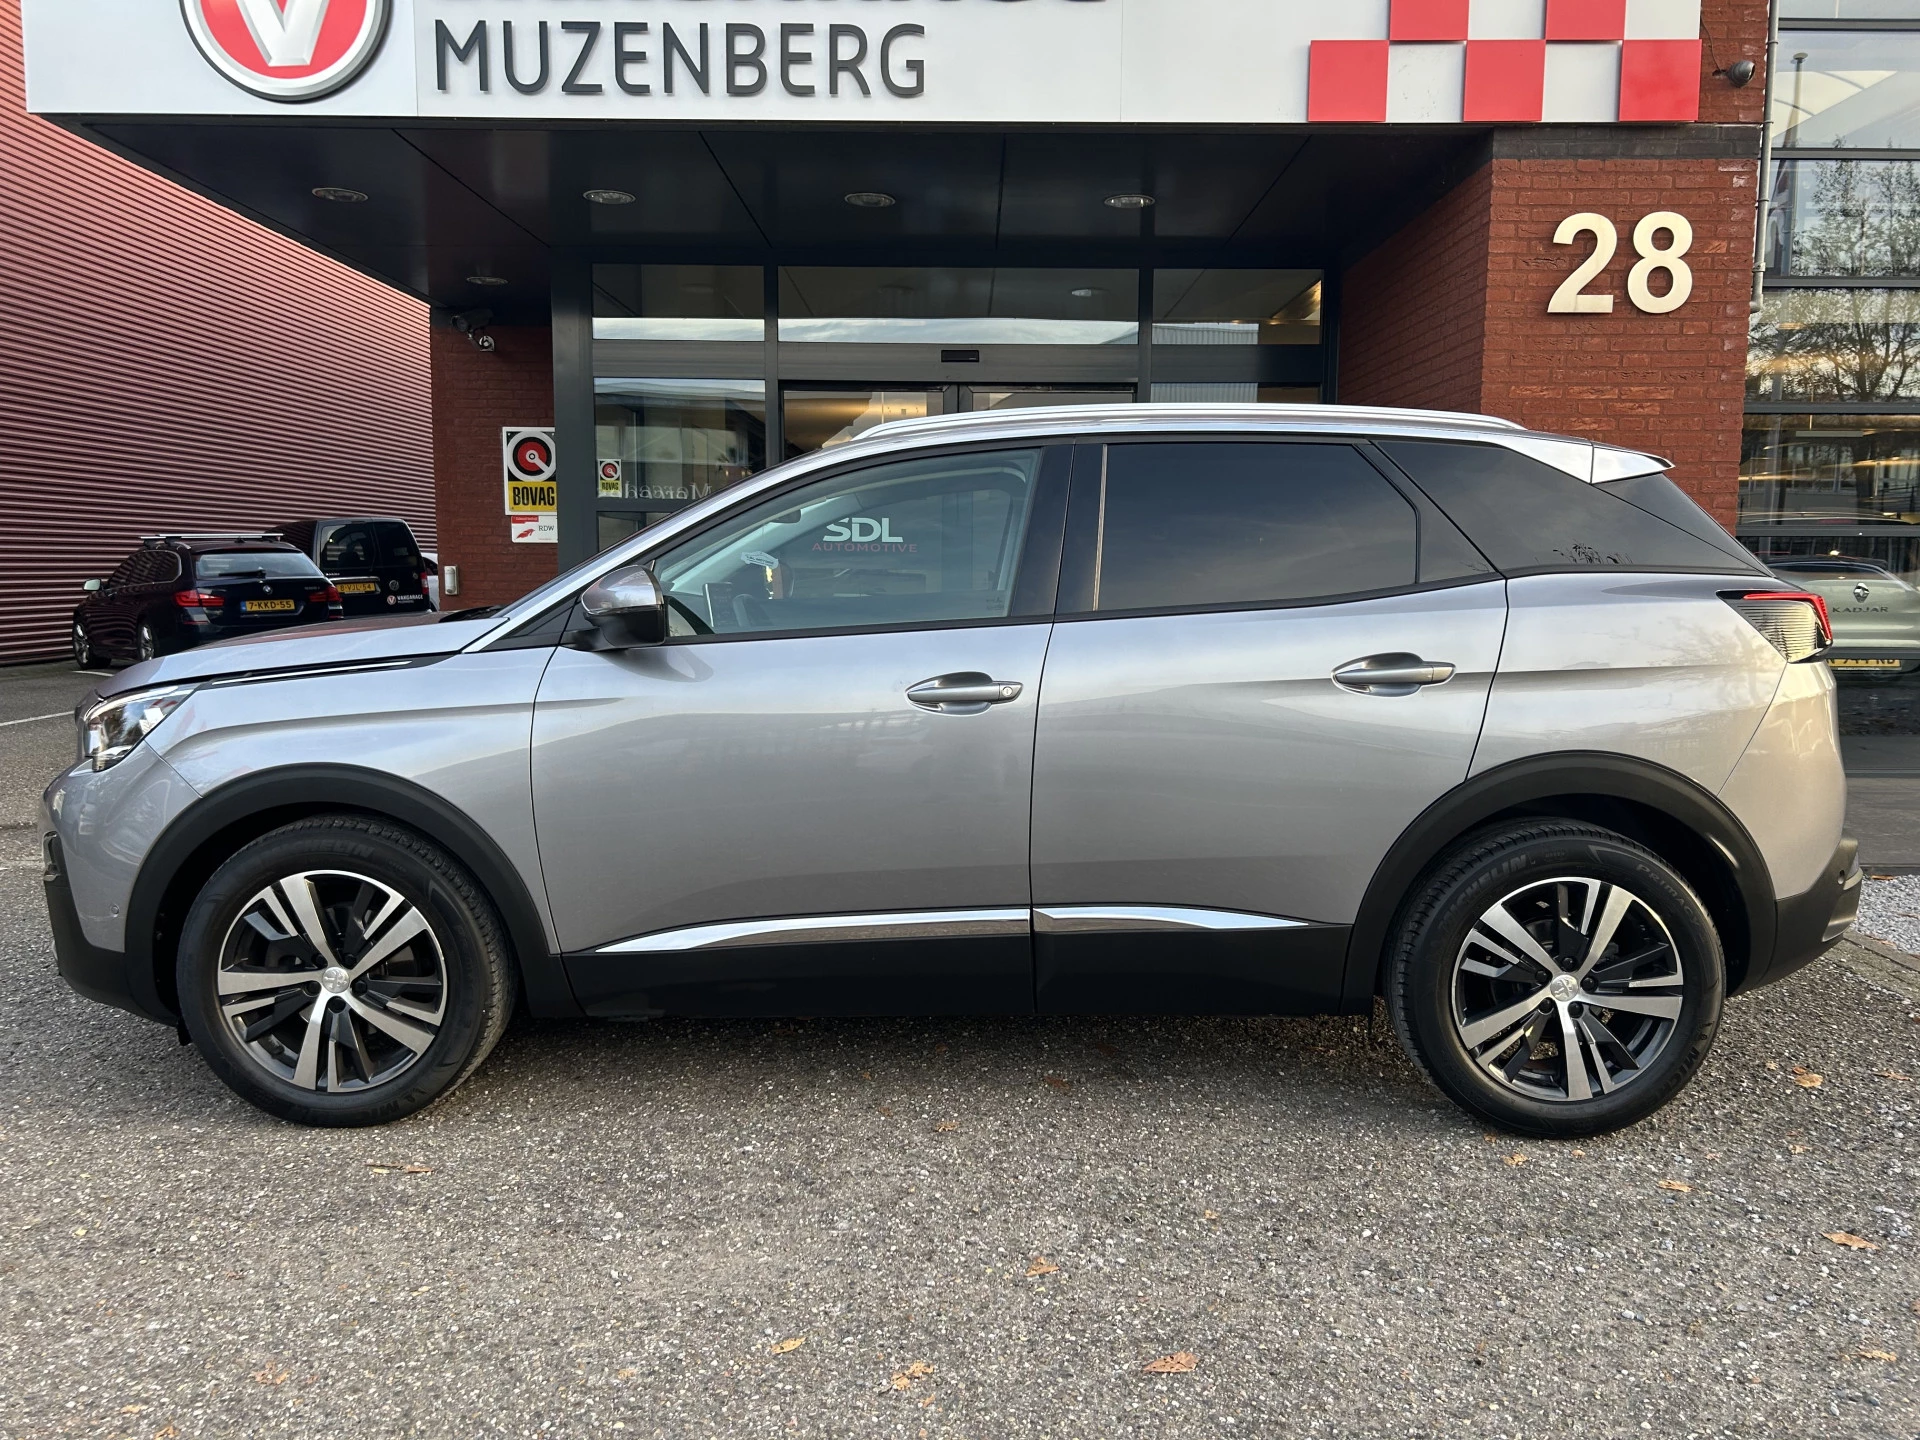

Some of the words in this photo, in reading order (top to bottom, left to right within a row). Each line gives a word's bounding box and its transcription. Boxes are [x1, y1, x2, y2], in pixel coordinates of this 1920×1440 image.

[434, 20, 926, 98] MUZENBERG
[1547, 211, 1693, 315] 28
[512, 486, 555, 506] BOVAG
[822, 517, 904, 543] SDL
[811, 543, 918, 553] AUTOMOTIVE
[248, 600, 293, 610] 7-KKD-55
